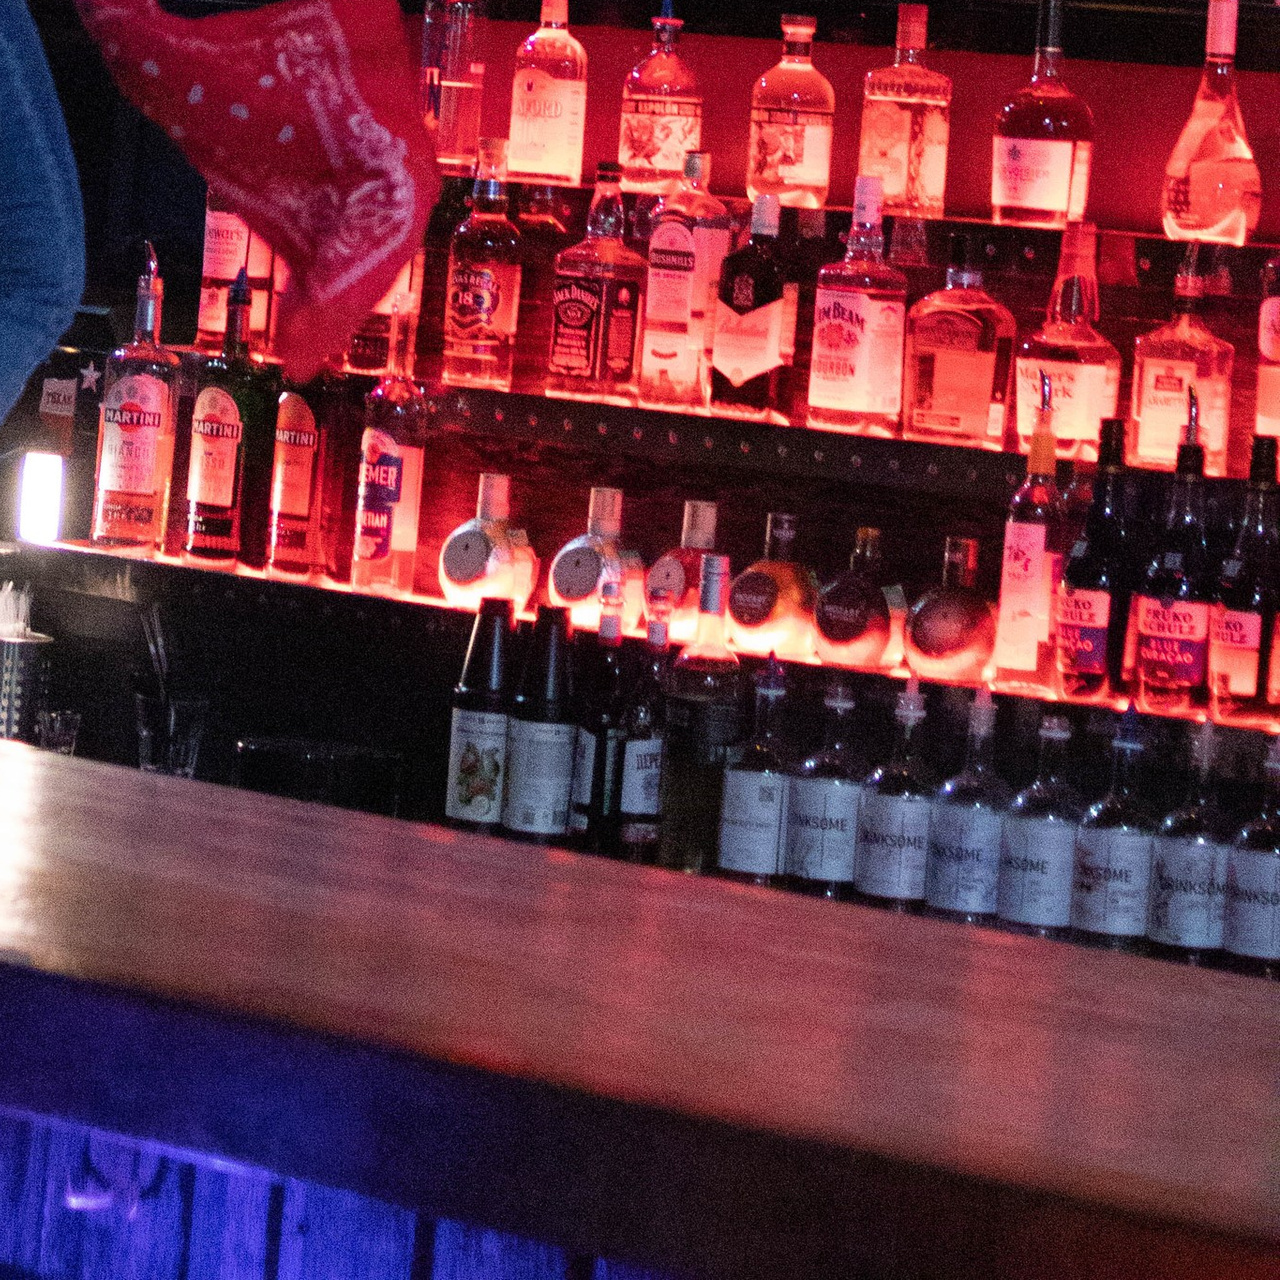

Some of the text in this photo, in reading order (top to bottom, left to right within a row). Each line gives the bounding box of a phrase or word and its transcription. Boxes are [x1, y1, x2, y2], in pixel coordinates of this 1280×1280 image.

[832, 301, 866, 333] BEAM
[1019, 365, 1075, 383] Maer's
[105, 409, 161, 427] MARTINI
[193, 421, 239, 438] MARTINI
